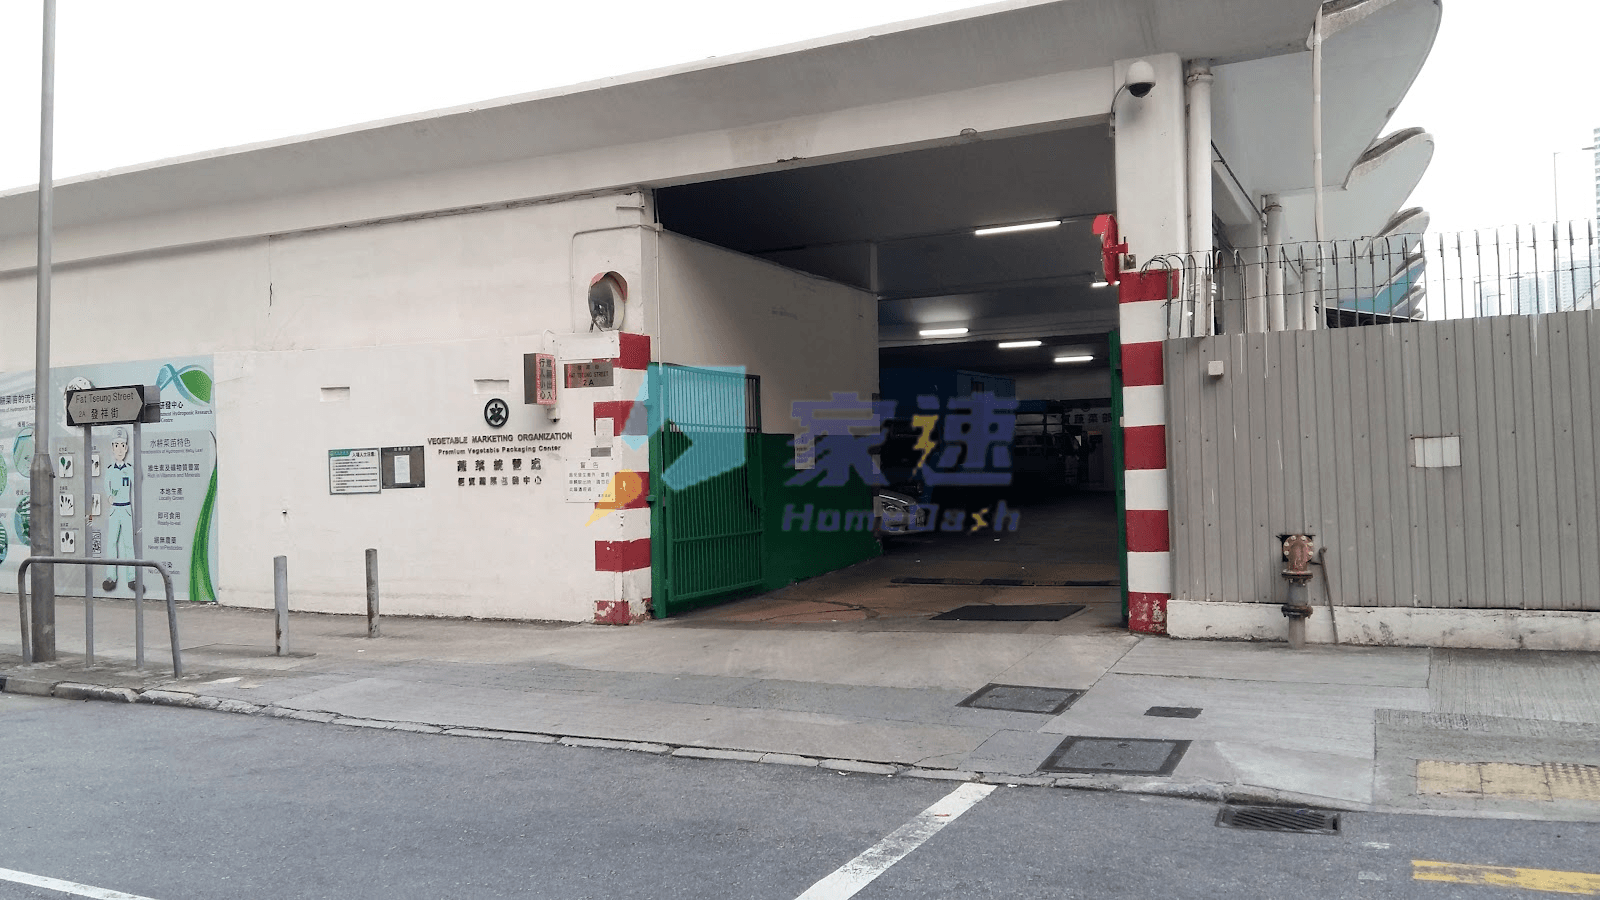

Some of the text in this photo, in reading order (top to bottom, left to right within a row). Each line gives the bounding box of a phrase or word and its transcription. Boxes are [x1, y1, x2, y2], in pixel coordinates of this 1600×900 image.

[75, 391, 134, 404] Fat Tseung Street
[78, 410, 86, 418] 2A
[91, 407, 119, 420] 發祥街
[427, 431, 573, 446] VEGETABLE MARKETING ORGANIZATION
[467, 447, 500, 455] Vegetable
[501, 445, 537, 454] Packaging
[159, 487, 183, 496] 本地生產
[157, 511, 181, 520] 即可食用
